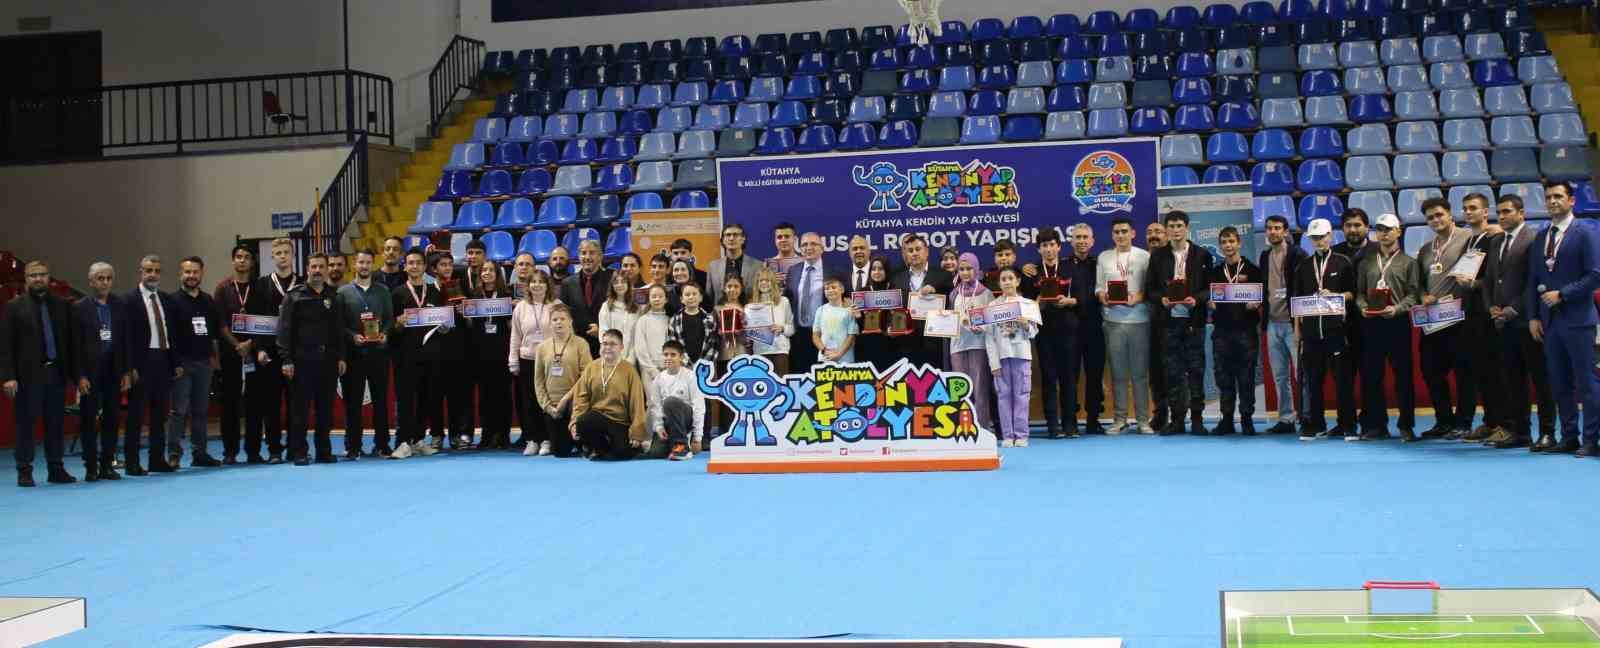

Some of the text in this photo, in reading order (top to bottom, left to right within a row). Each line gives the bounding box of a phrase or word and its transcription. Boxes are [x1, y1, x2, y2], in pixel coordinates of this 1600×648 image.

[760, 167, 801, 177] KÜTAHYA
[855, 212, 1020, 229] KÜTAHYA KENDİN YAP ATÖLYESİ
[816, 367, 876, 382] KÜTAHYA
